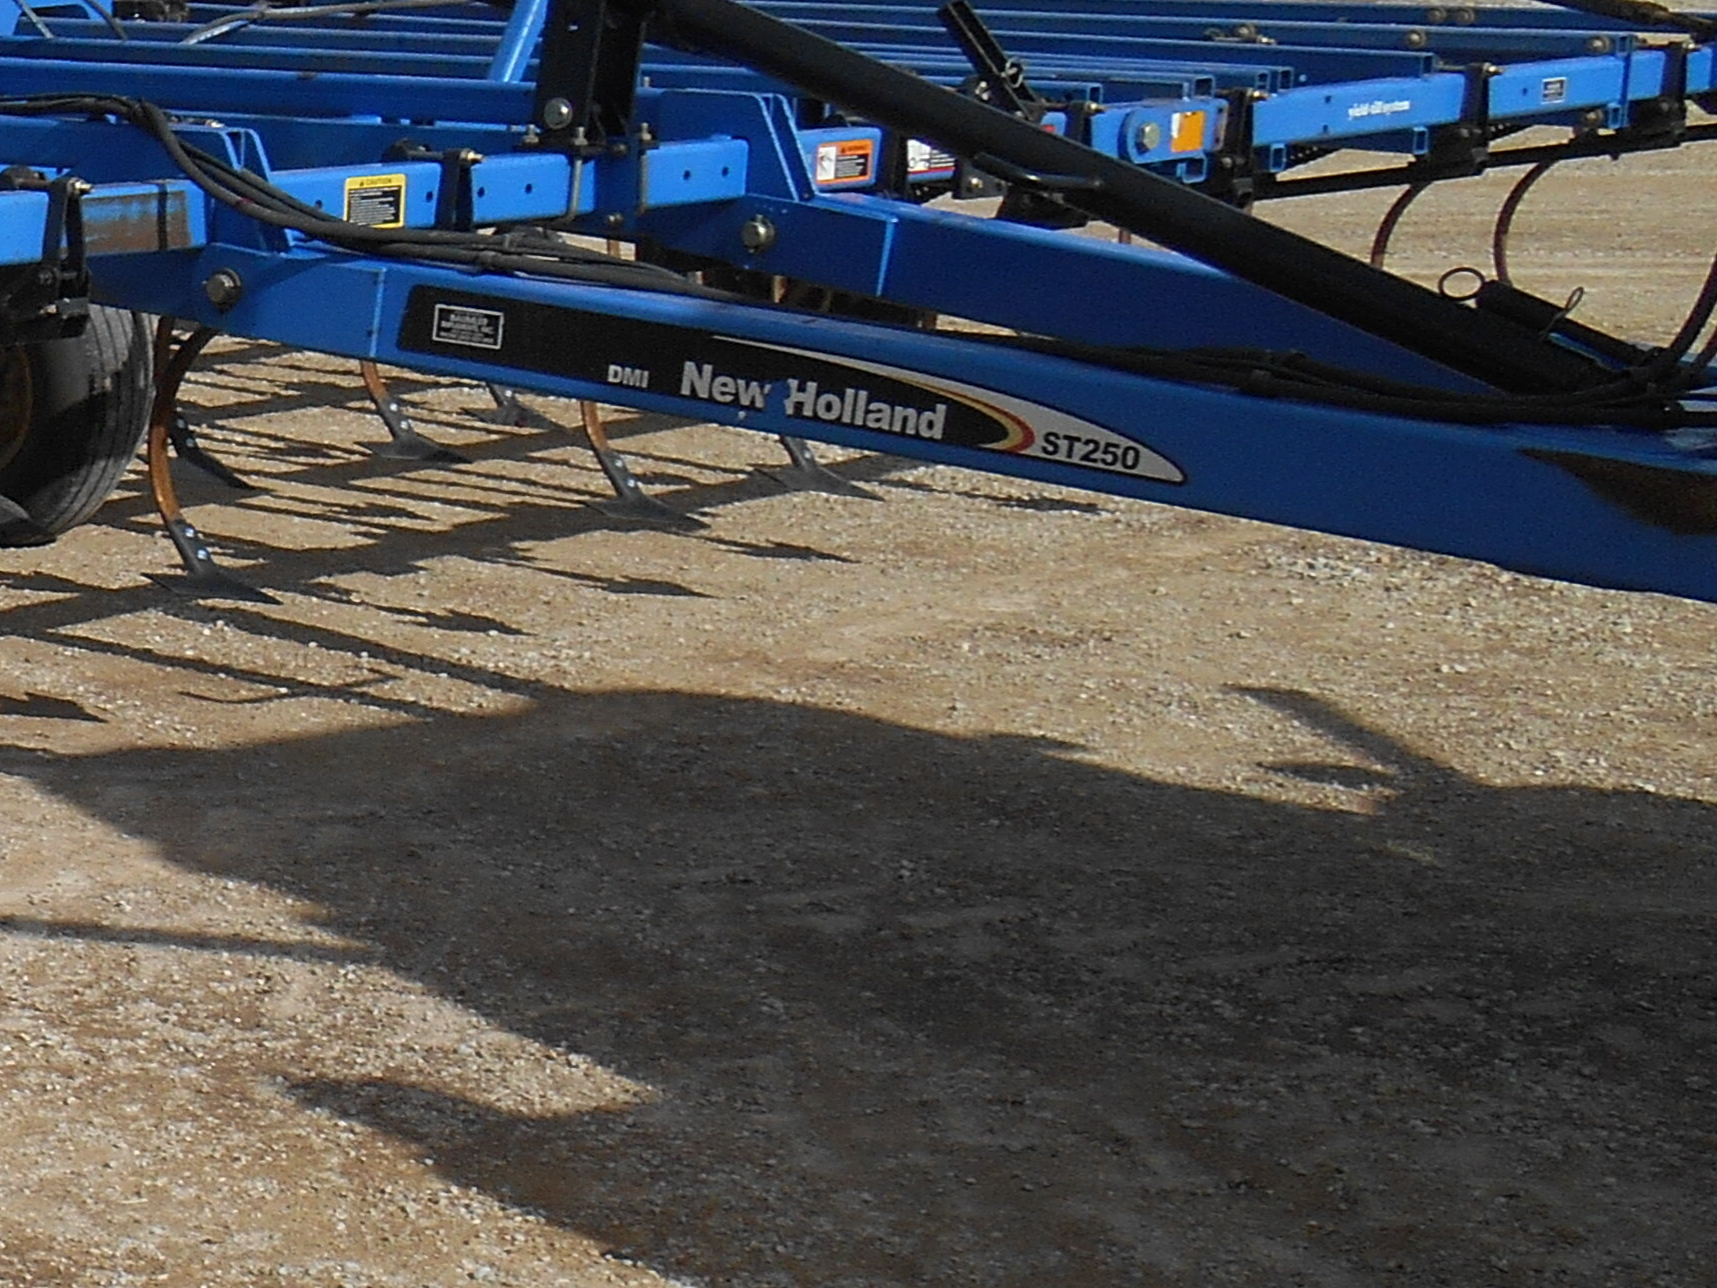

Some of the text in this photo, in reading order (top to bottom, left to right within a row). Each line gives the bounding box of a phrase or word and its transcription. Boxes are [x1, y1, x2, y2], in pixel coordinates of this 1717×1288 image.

[607, 360, 1141, 470] DMI New Holland ST250
